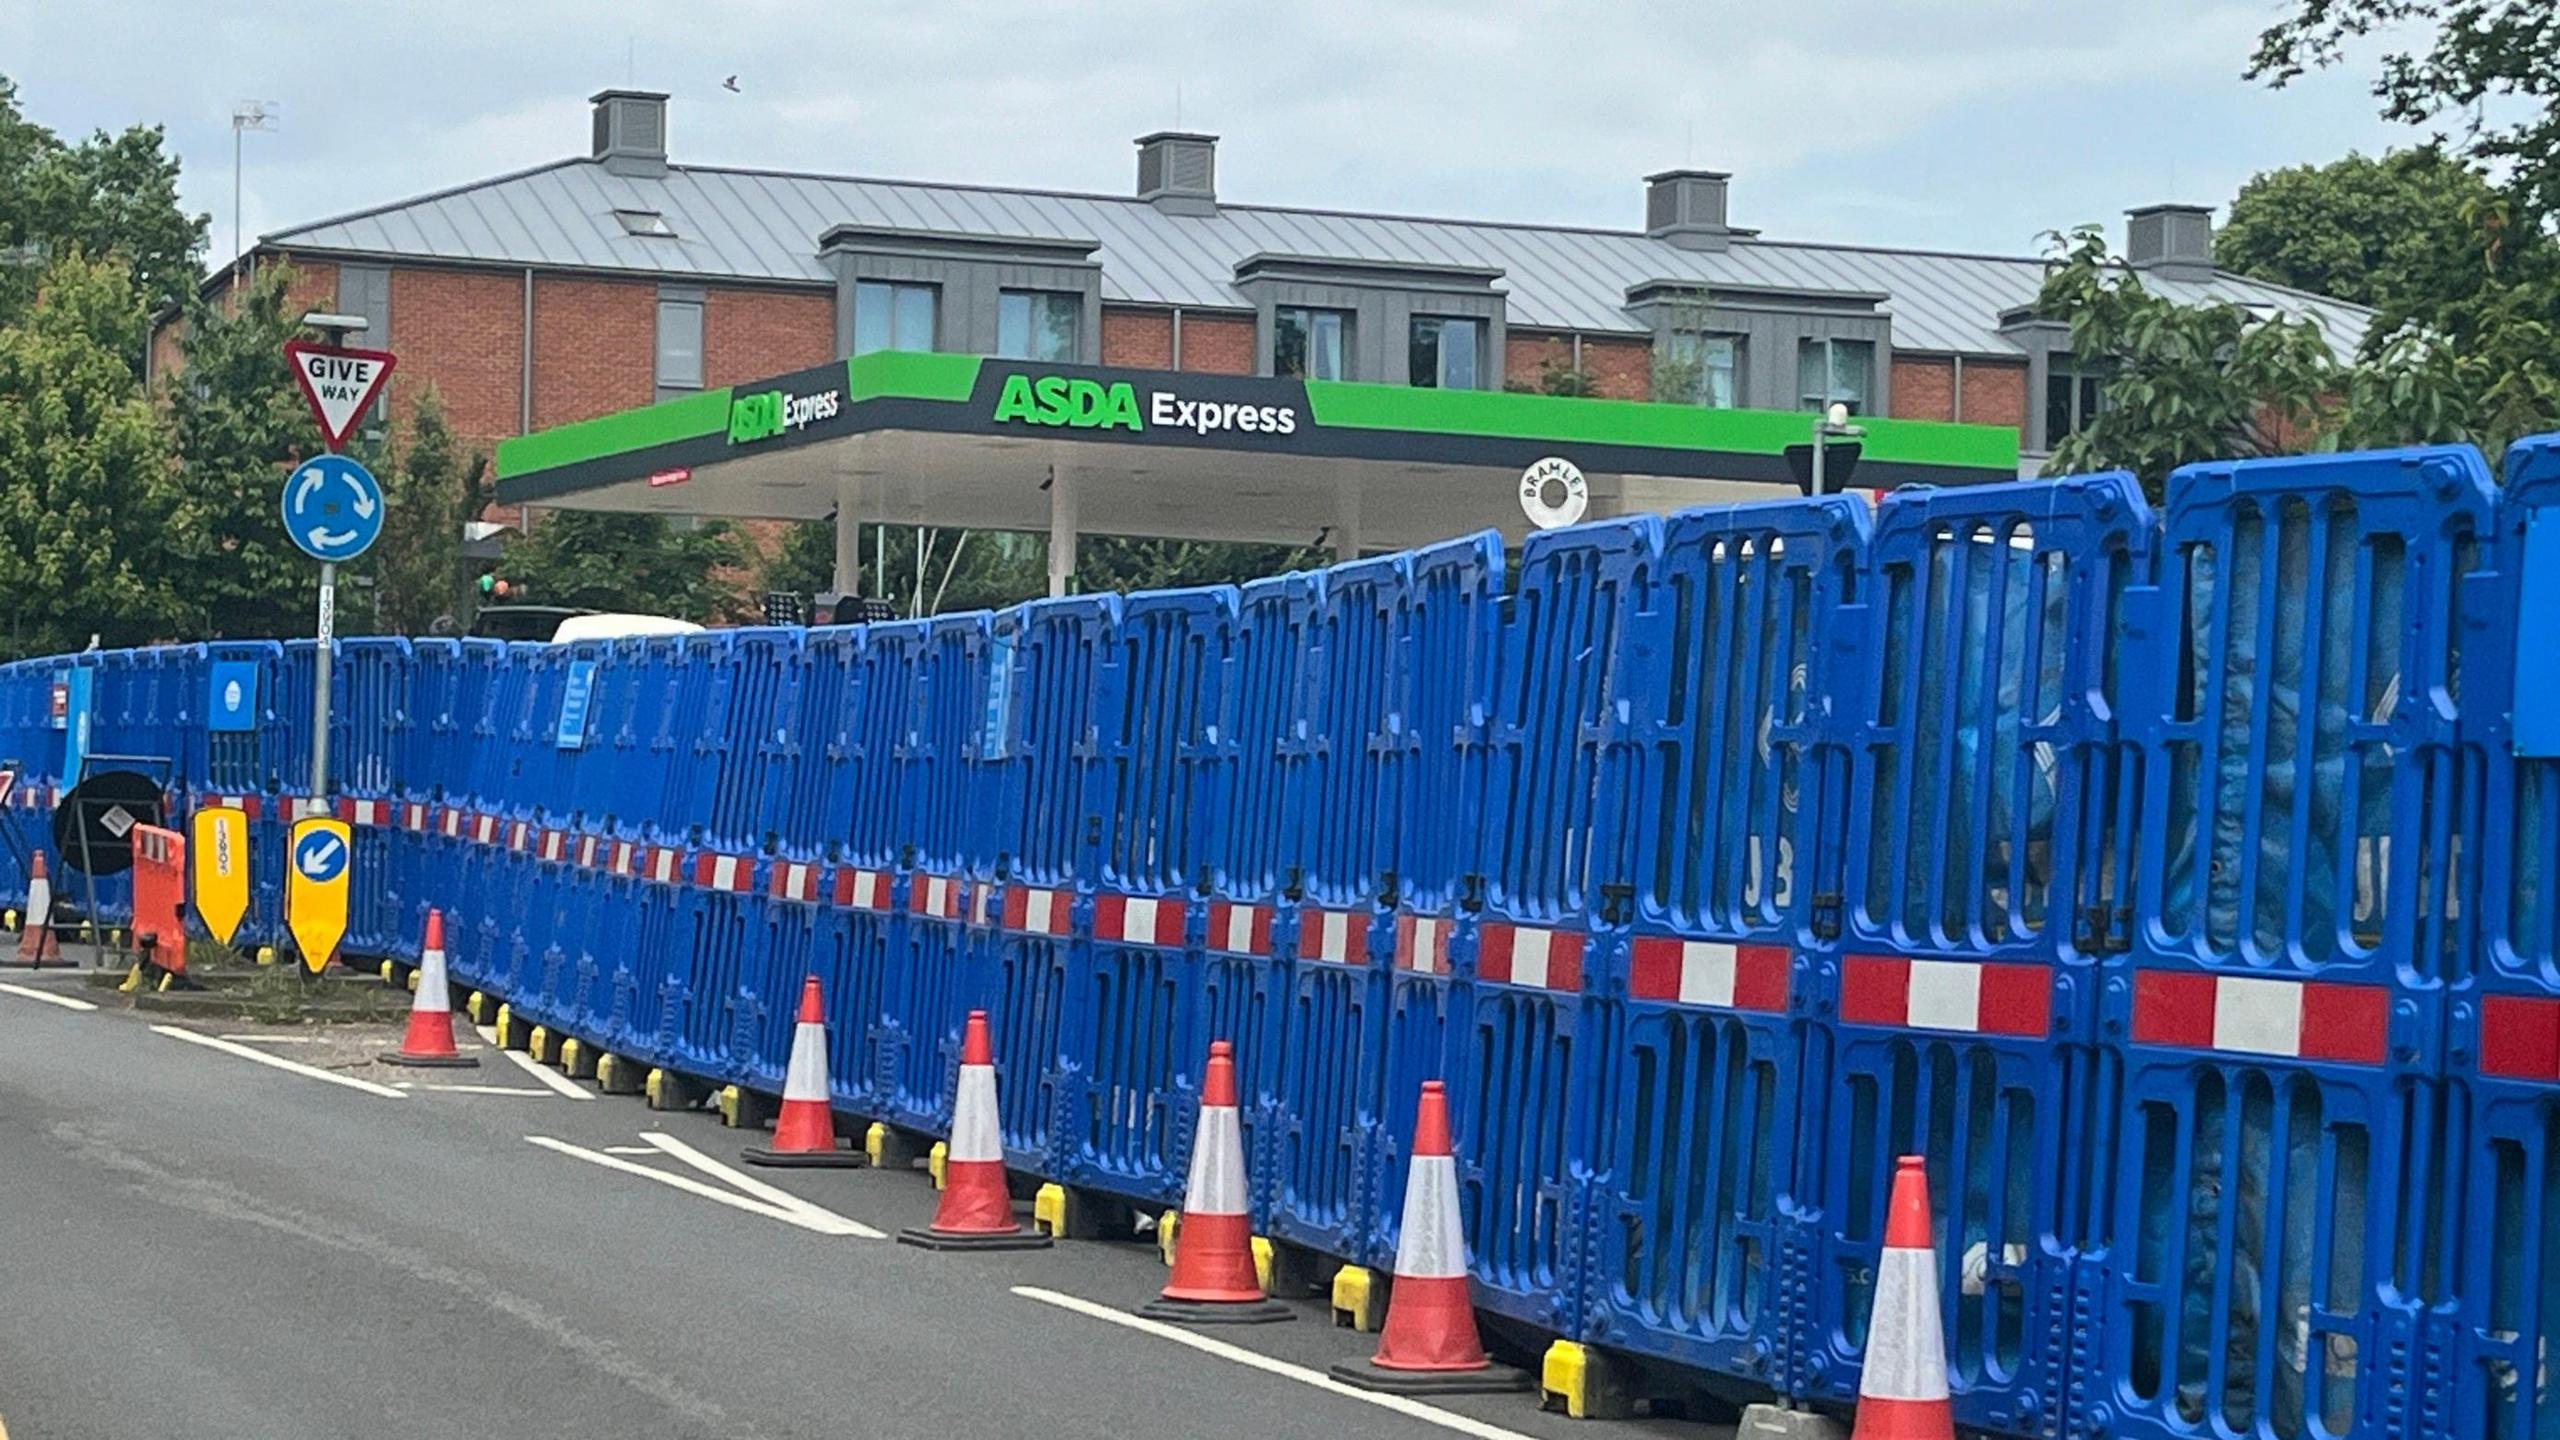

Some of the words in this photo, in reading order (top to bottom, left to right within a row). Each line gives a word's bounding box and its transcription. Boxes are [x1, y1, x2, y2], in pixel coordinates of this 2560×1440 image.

[309, 358, 369, 383] GIVE
[321, 384, 360, 402] WAY
[993, 375, 1143, 431] ASDA
[1151, 391, 1296, 435] Express
[727, 391, 785, 445] ASDA
[783, 390, 838, 431] Express
[1523, 462, 1585, 500] BRAMLEY
